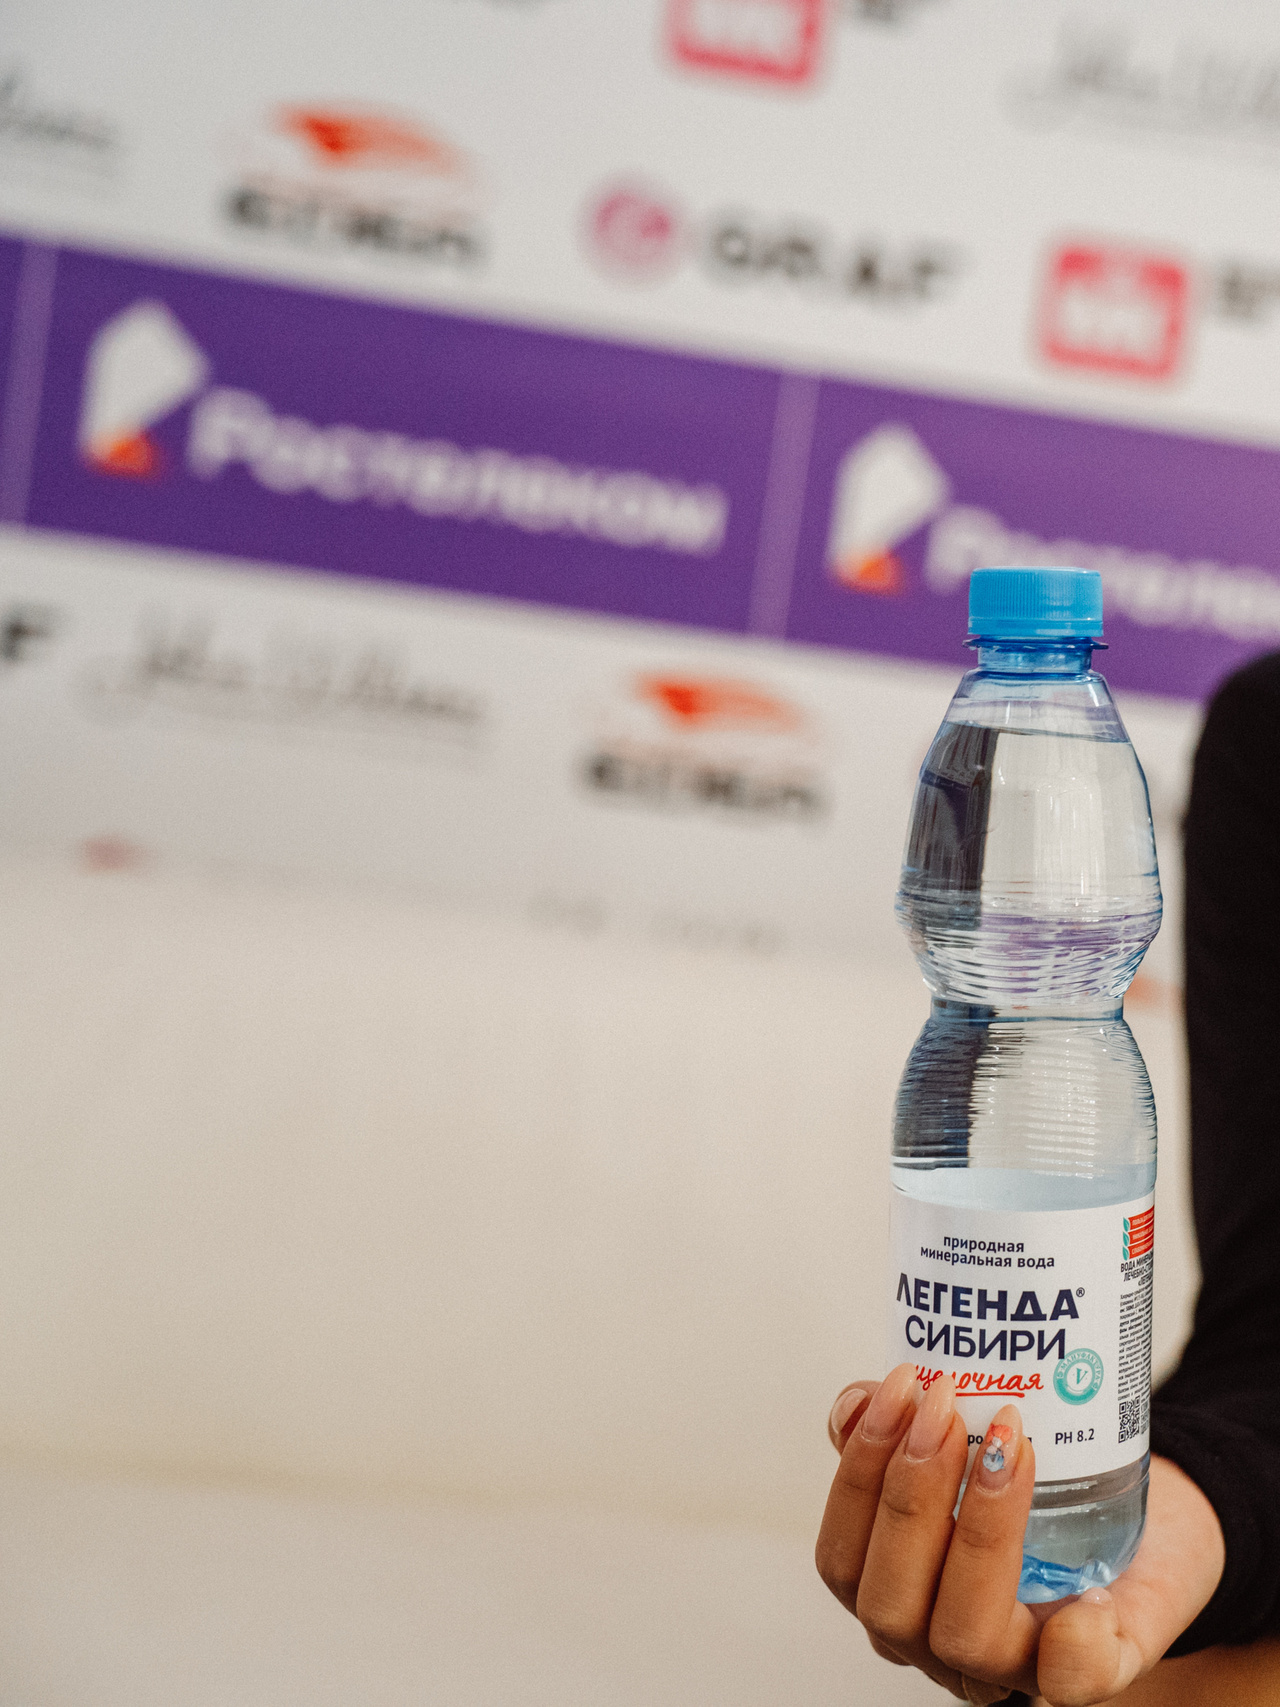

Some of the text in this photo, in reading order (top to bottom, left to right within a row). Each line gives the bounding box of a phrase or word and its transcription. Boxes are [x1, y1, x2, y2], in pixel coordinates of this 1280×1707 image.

[943, 1236, 1025, 1253] природная
[920, 1247, 1055, 1270] минеральная вода
[905, 1314, 1066, 1361] СИБИРИ
[1076, 1367, 1088, 1385] V
[1076, 1428, 1095, 1443] 8.2
